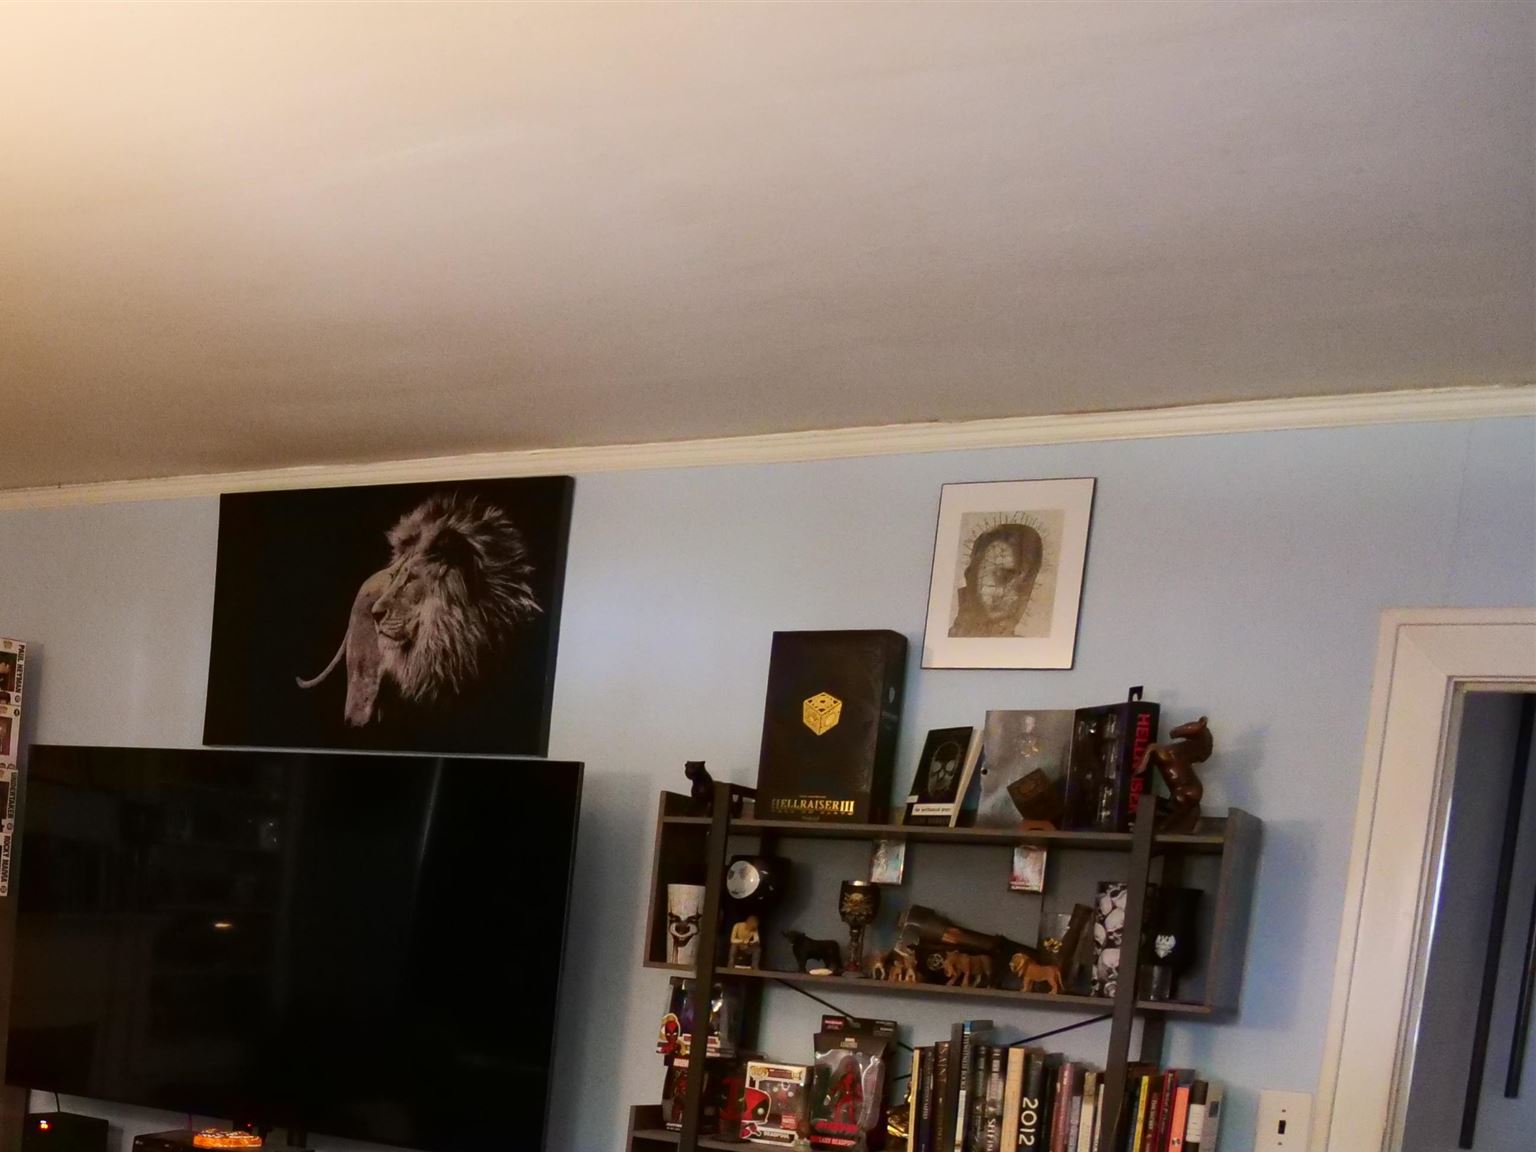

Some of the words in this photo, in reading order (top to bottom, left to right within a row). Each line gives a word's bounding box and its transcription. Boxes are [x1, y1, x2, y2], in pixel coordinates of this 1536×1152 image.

[17, 644, 25, 663] PAUL
[14, 664, 23, 693] HEYMAN
[8, 772, 18, 819] UNDERTAKER
[771, 798, 839, 812] HELLRAISER
[839, 800, 855, 816] III
[1019, 1097, 1039, 1148] 2012
